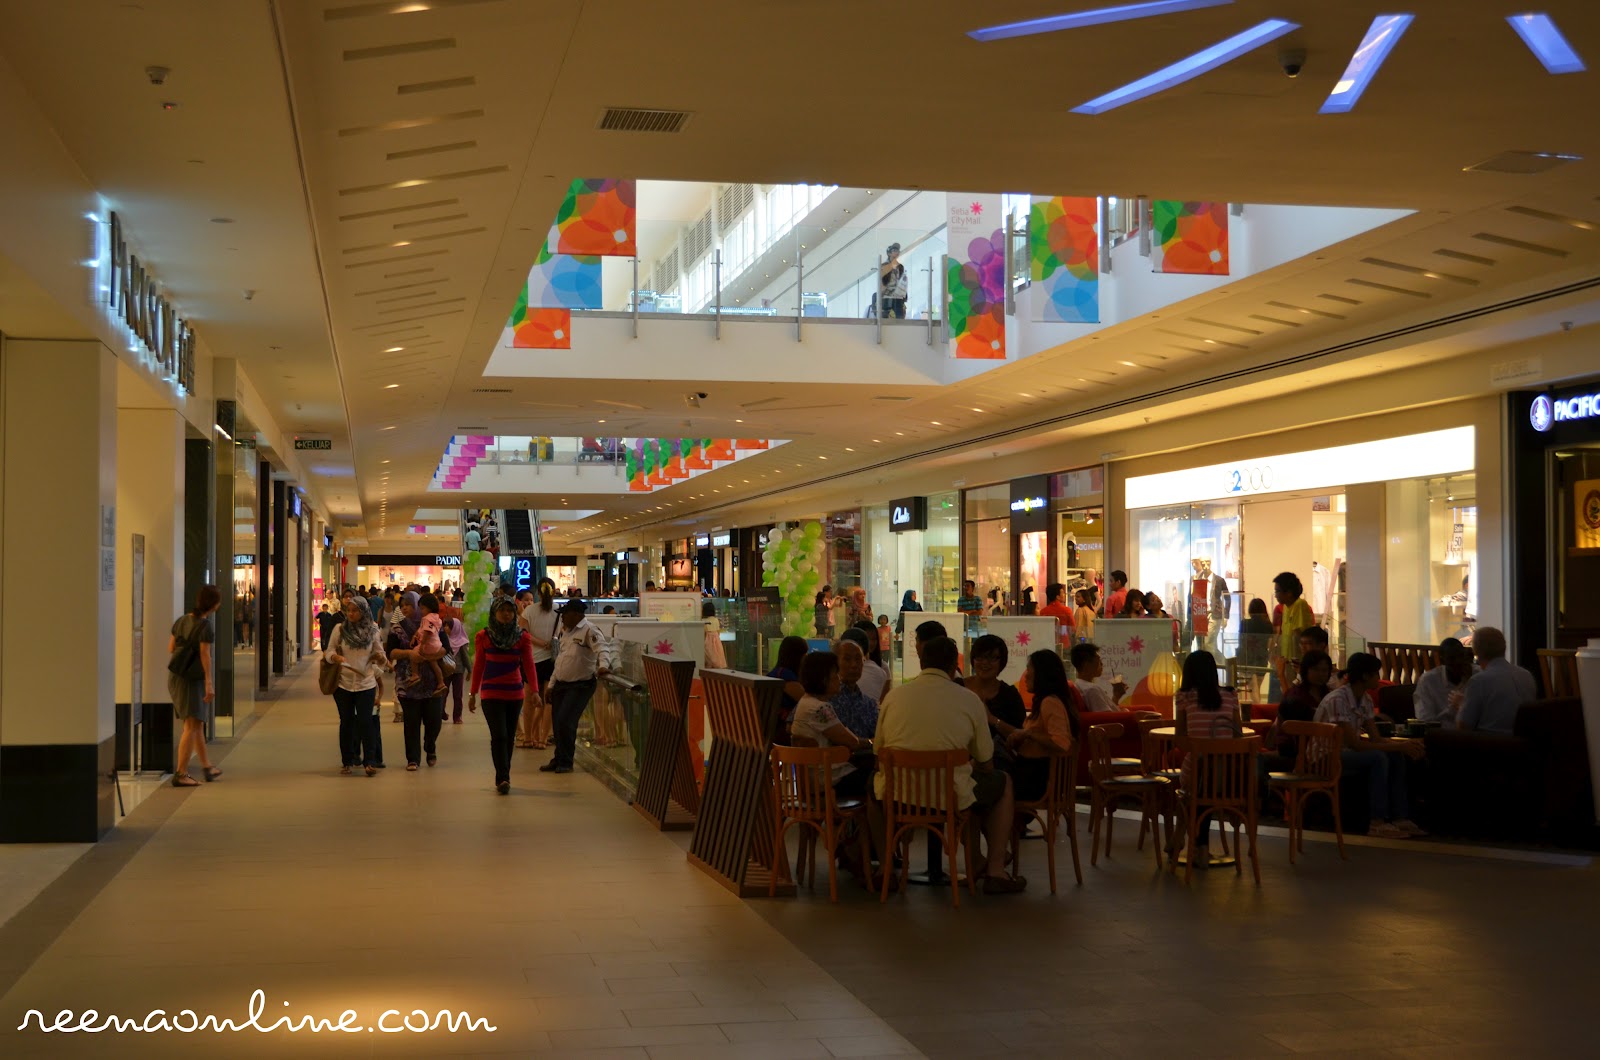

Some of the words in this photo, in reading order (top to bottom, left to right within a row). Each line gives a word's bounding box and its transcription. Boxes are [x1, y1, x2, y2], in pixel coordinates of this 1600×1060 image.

[951, 207, 969, 215] Setia
[951, 216, 965, 226] City
[966, 217, 981, 225] Mall
[302, 440, 331, 449] KELUAR
[1192, 603, 1207, 616] Sale
[1010, 649, 1028, 657] Mall
[1100, 644, 1126, 655] Setia
[1120, 656, 1142, 668] Mall
